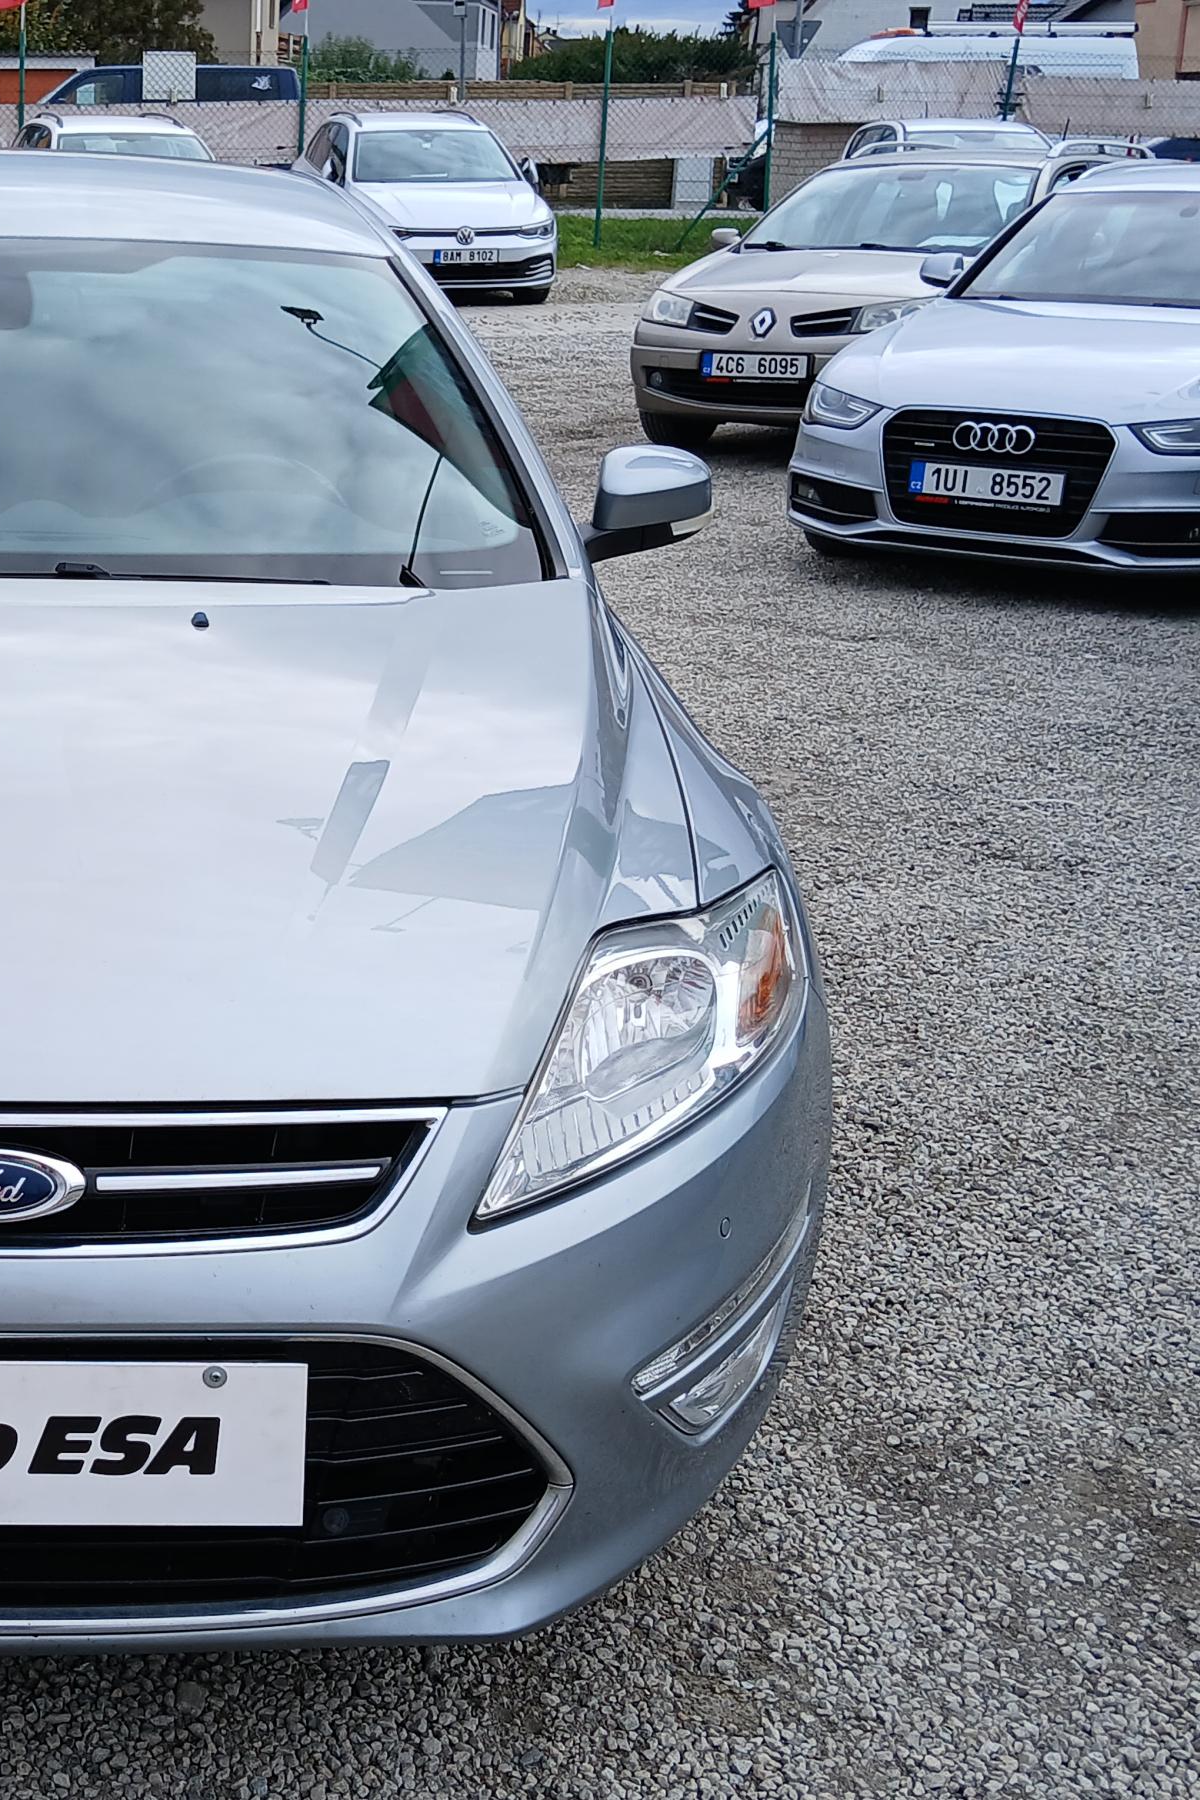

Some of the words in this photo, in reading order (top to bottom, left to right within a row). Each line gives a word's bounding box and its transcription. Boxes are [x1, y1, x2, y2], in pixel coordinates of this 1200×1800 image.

[442, 251, 462, 262] 8AM
[469, 250, 494, 262] 8102
[715, 356, 745, 374] 4C6
[757, 357, 800, 375] 6095
[931, 467, 969, 493] 1UI
[990, 472, 1052, 501] 8552
[27, 1415, 221, 1476] ESA
